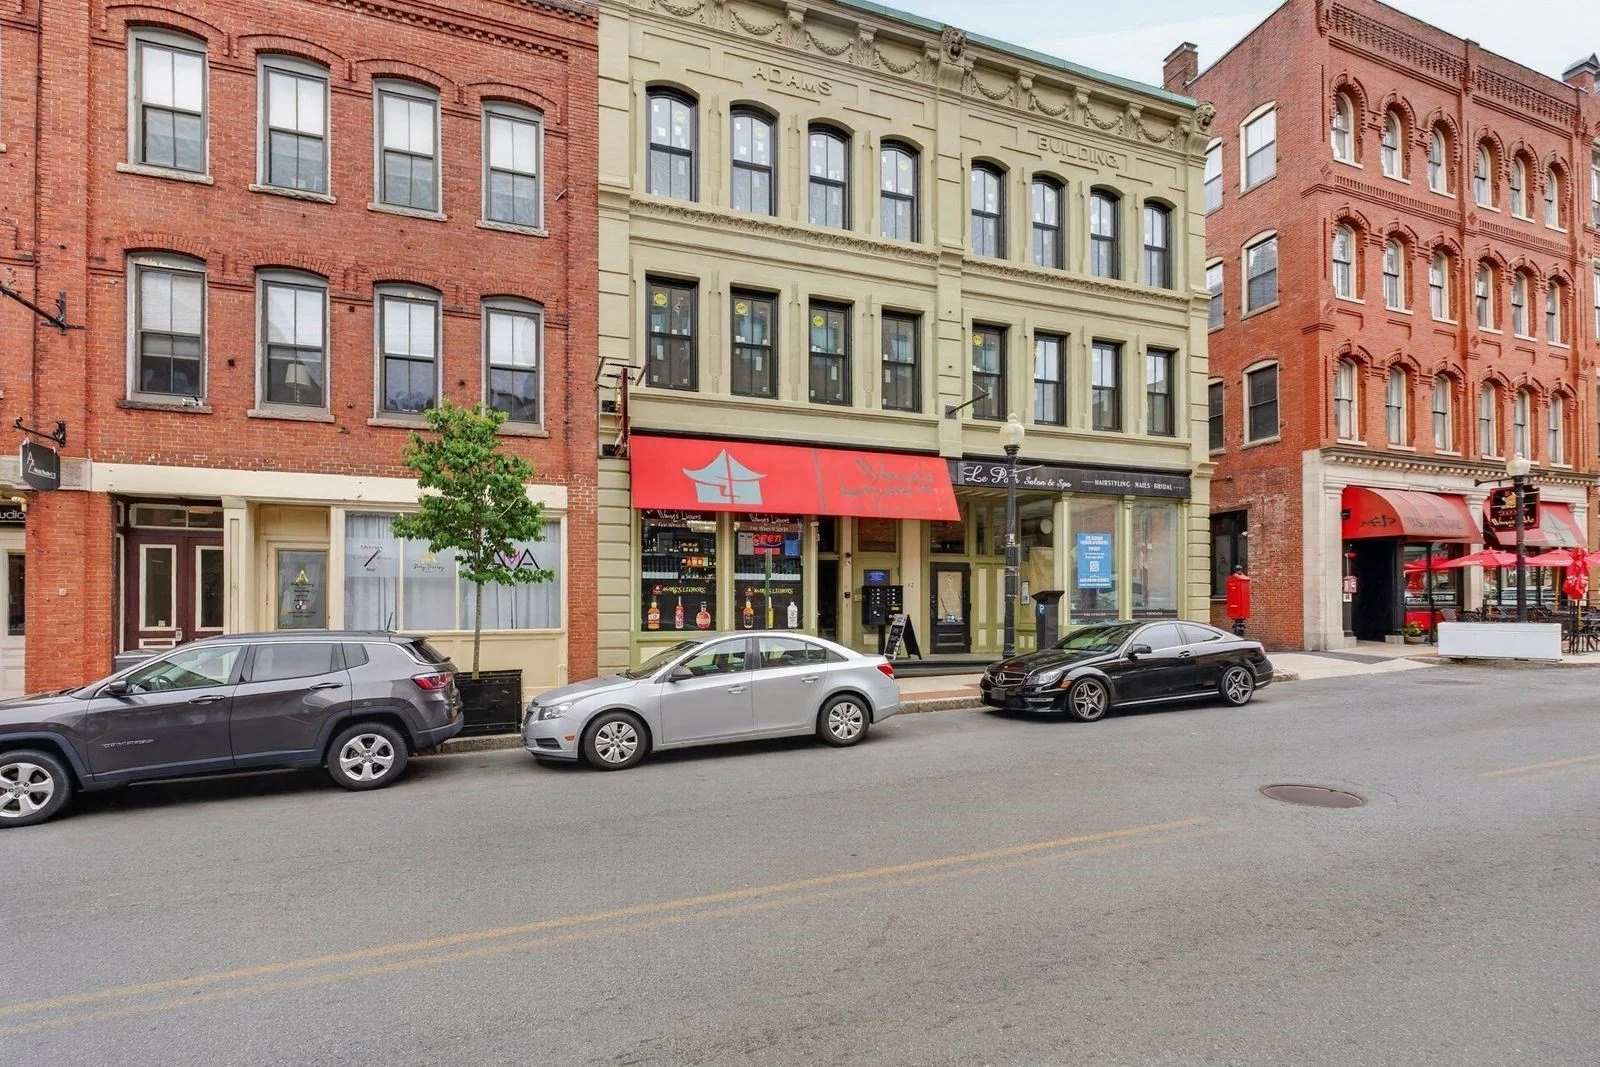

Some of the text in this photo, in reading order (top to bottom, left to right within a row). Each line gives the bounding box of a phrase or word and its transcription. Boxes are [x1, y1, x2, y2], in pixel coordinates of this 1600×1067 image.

[752, 66, 833, 97] ADAMS
[1037, 135, 1120, 170] BUILDING
[963, 465, 988, 483] Le
[1023, 476, 1046, 486] Salon
[1047, 478, 1055, 487] &
[1056, 479, 1072, 489] Spa
[1094, 479, 1131, 488] HAIRSTYLING
